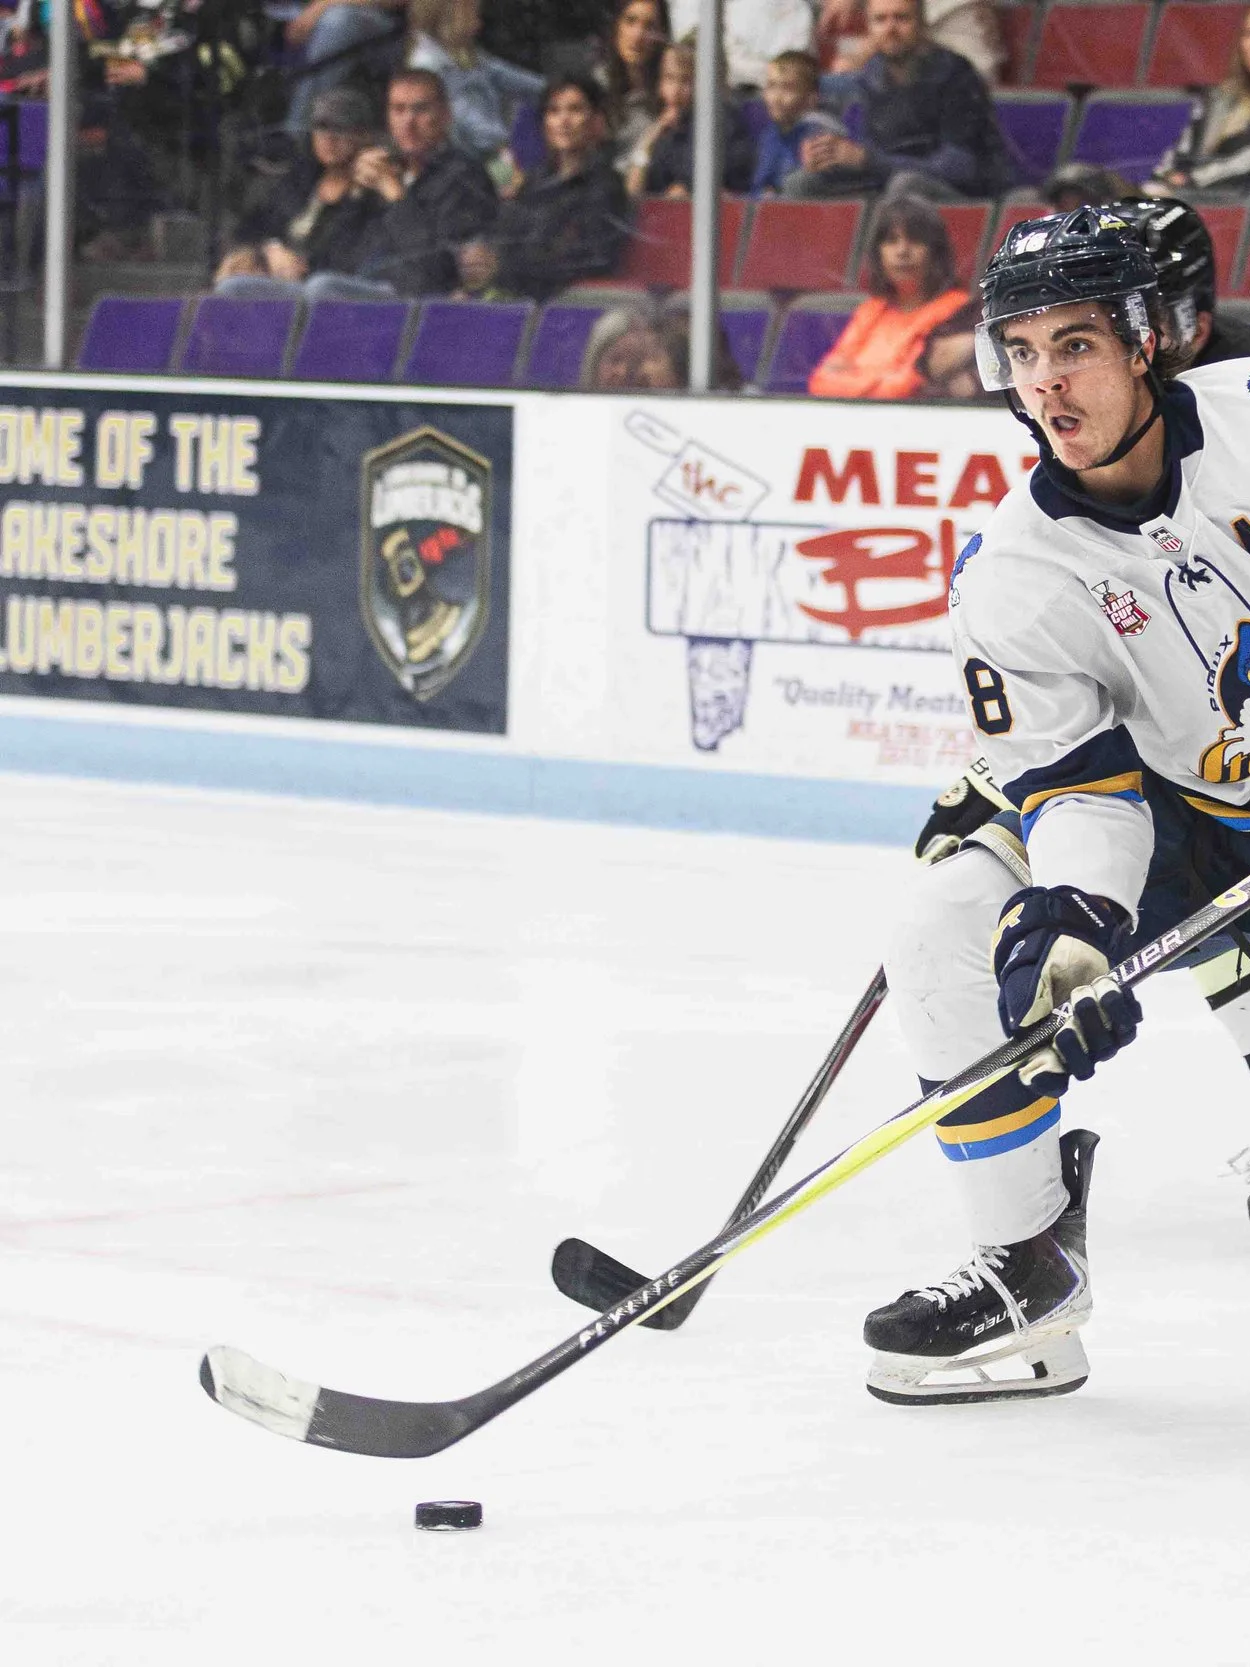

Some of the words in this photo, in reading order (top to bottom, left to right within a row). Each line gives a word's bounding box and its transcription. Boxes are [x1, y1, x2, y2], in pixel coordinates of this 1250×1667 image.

[95, 410, 157, 491] OF
[170, 413, 261, 496] THE
[1111, 605, 1133, 624] CUP
[1120, 614, 1138, 628] FINAL
[0, 596, 312, 693] UMBERJACKS
[973, 1297, 1028, 1337] BAUR
